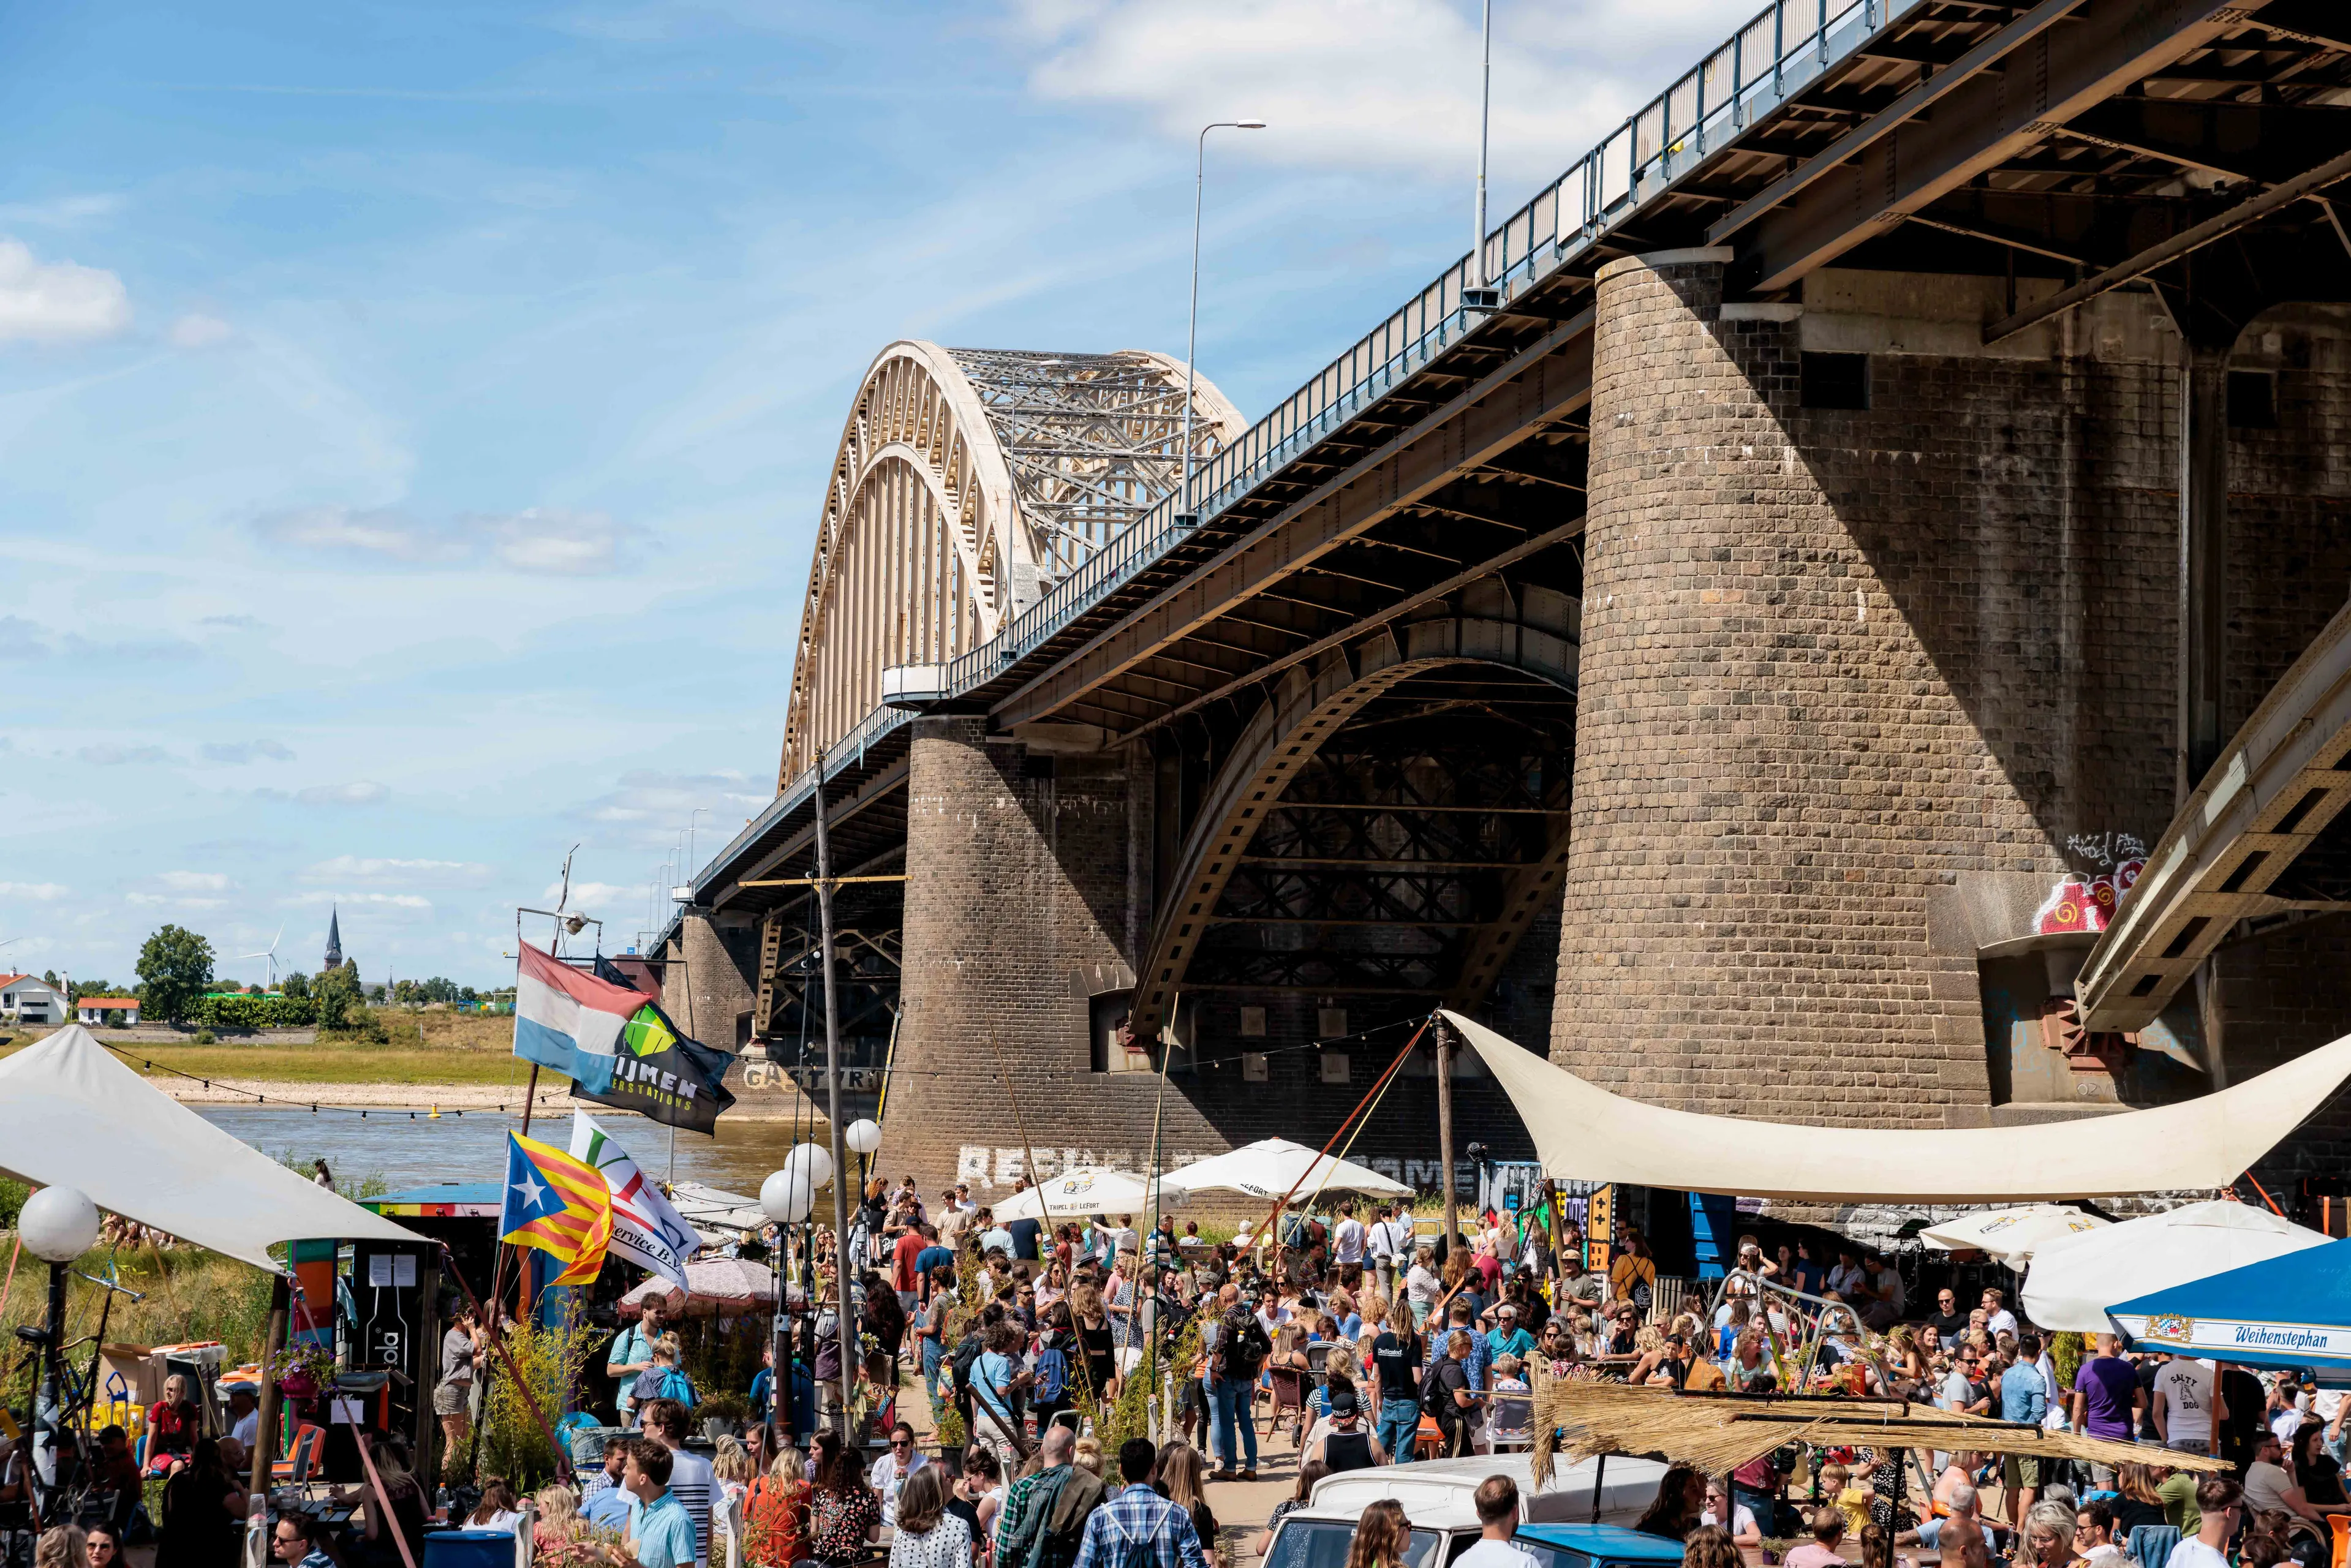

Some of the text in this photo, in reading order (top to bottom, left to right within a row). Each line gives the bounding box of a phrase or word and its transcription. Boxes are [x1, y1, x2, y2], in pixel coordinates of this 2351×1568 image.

[612, 1057, 698, 1098] IJMEN
[613, 1078, 692, 1110] ERSTATIONS
[375, 1333, 398, 1365] ola
[2236, 1326, 2327, 1349] Weihenstephan
[2170, 1374, 2198, 1387] SALTY
